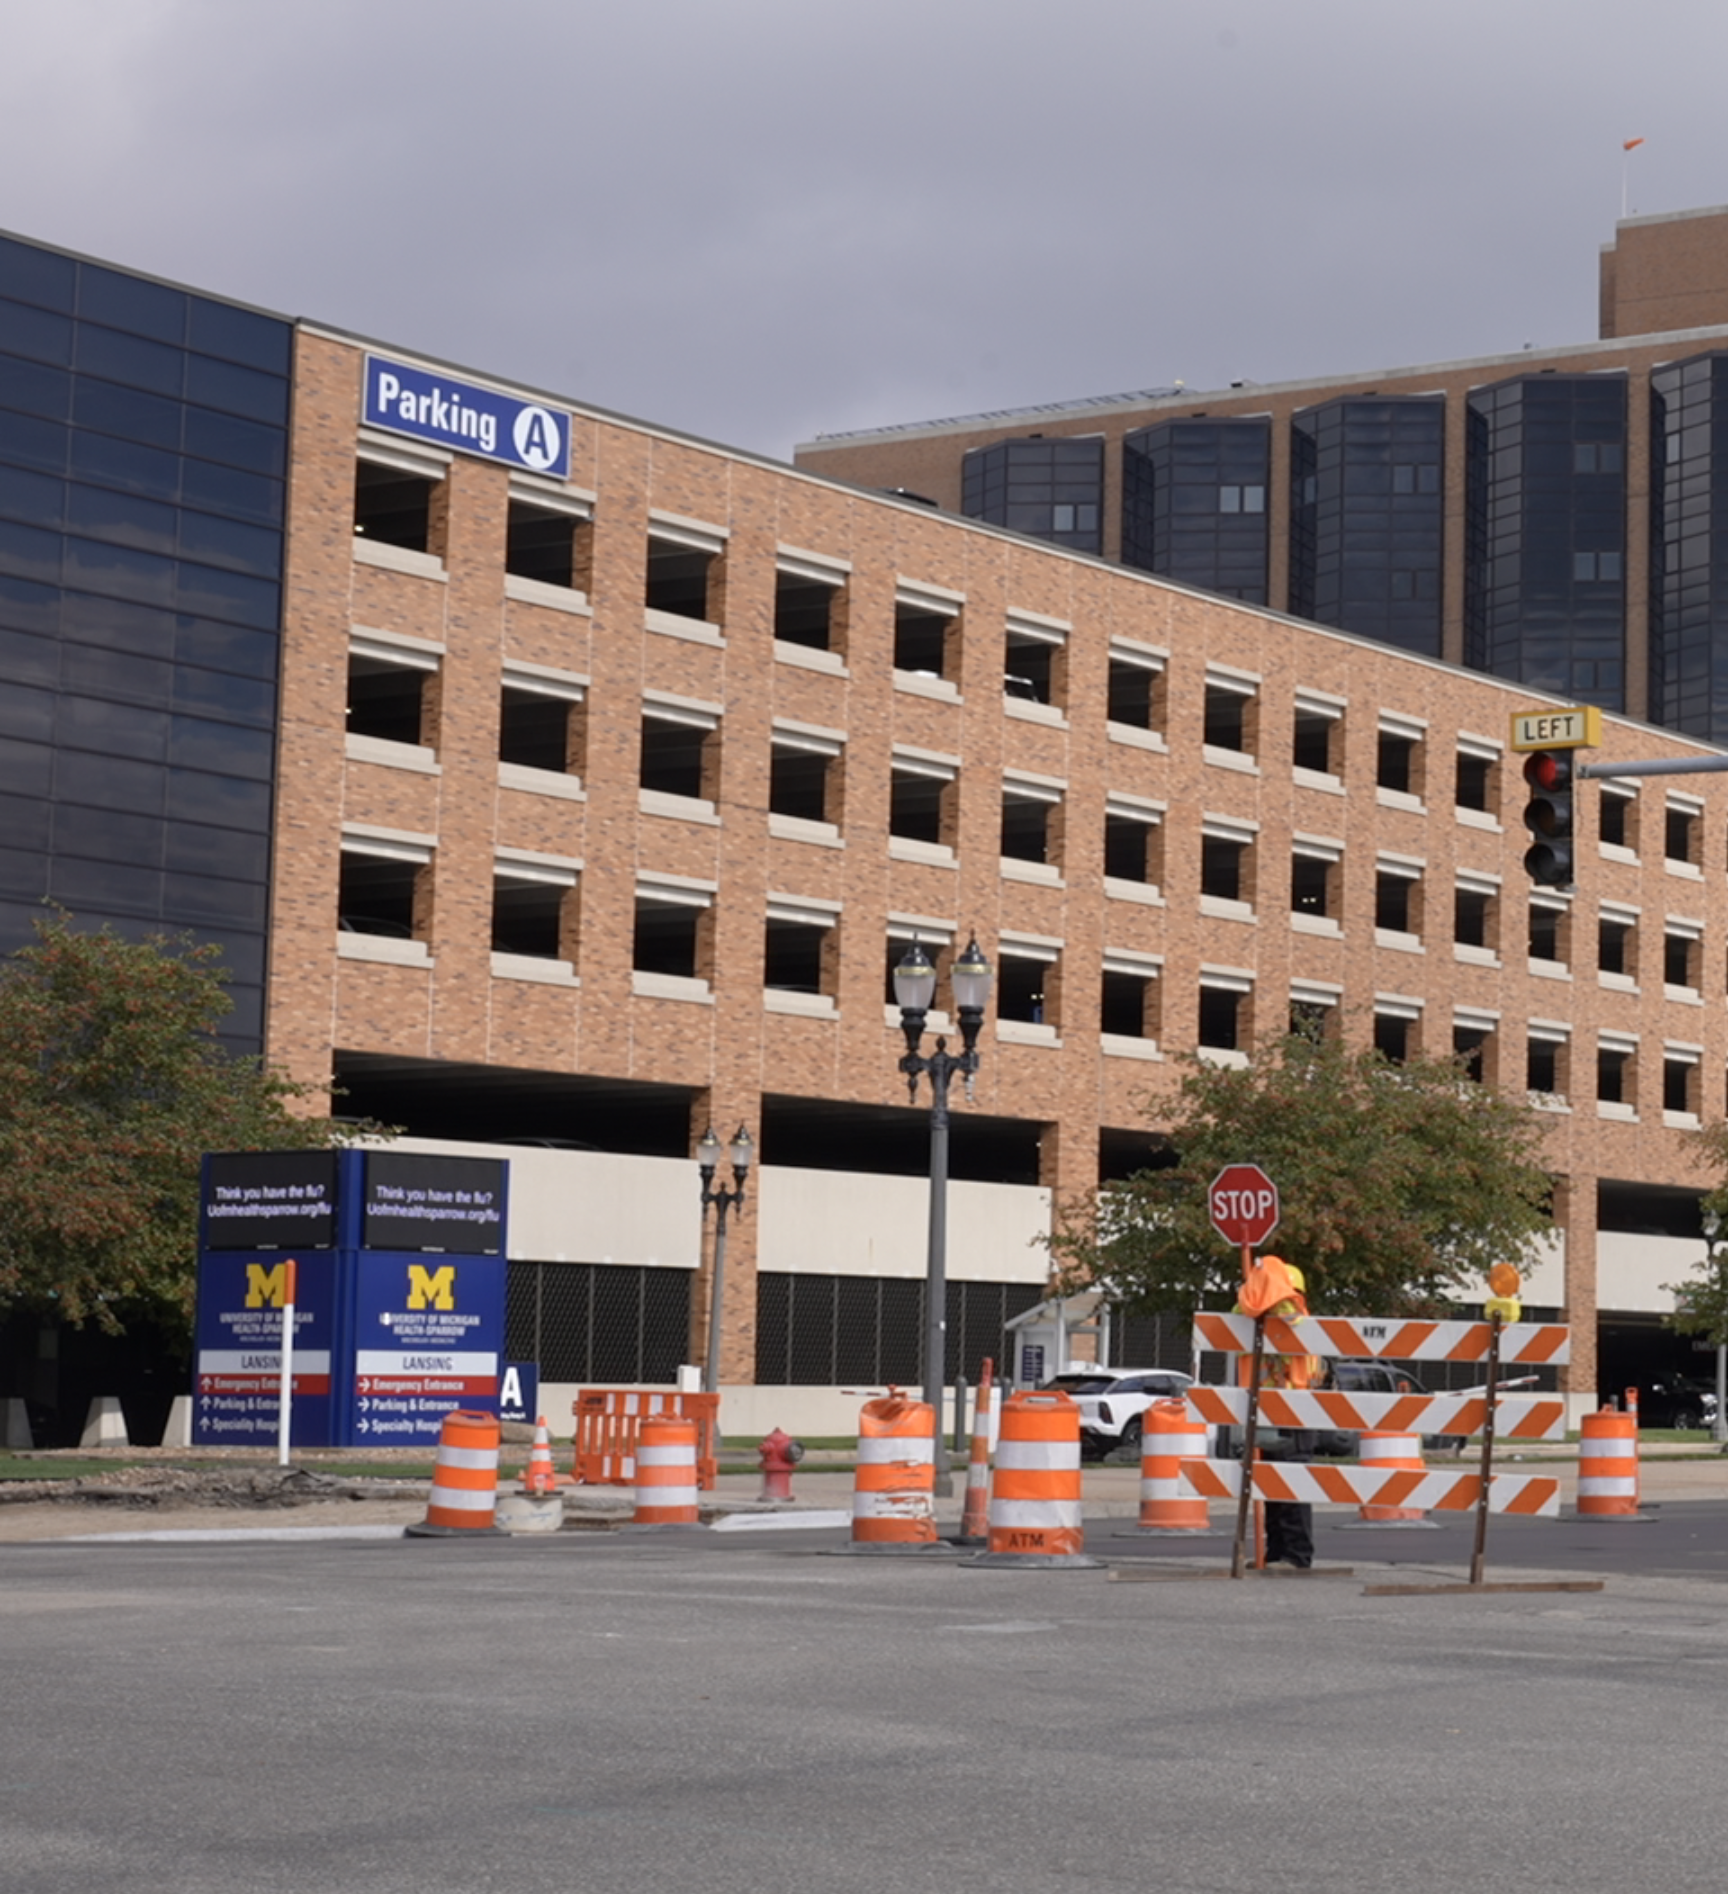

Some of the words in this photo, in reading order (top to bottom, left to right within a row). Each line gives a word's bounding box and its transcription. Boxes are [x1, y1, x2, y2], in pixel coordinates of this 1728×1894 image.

[378, 372, 497, 452] Parking
[523, 413, 550, 461] A
[1524, 716, 1574, 741] LEFT
[215, 1186, 242, 1200] Think
[244, 1188, 261, 1202] you
[262, 1185, 286, 1199] have
[288, 1184, 304, 1198] the
[306, 1184, 325, 1198] flu?
[376, 1185, 406, 1200] Think
[406, 1188, 426, 1203] you
[427, 1188, 453, 1203] have
[455, 1190, 472, 1203] the
[473, 1191, 493, 1204] flu?
[1214, 1190, 1273, 1220] STOP
[245, 1263, 286, 1308] M
[406, 1264, 455, 1310] M
[380, 1313, 426, 1324] UIVERSITY
[428, 1313, 438, 1324] OF
[439, 1314, 480, 1326] MICHIGAN
[241, 1355, 283, 1369] LANSIN
[403, 1356, 453, 1370] LANSING
[214, 1377, 260, 1392] Emergency
[372, 1378, 422, 1393] Emergency
[424, 1378, 465, 1391] Entrance
[500, 1366, 523, 1407] A
[213, 1396, 246, 1412] Parking
[372, 1398, 408, 1414] Parking
[409, 1398, 416, 1411] &
[419, 1398, 460, 1411] Entrance
[416, 1419, 442, 1434] Hospi
[1008, 1533, 1044, 1548] ATM
